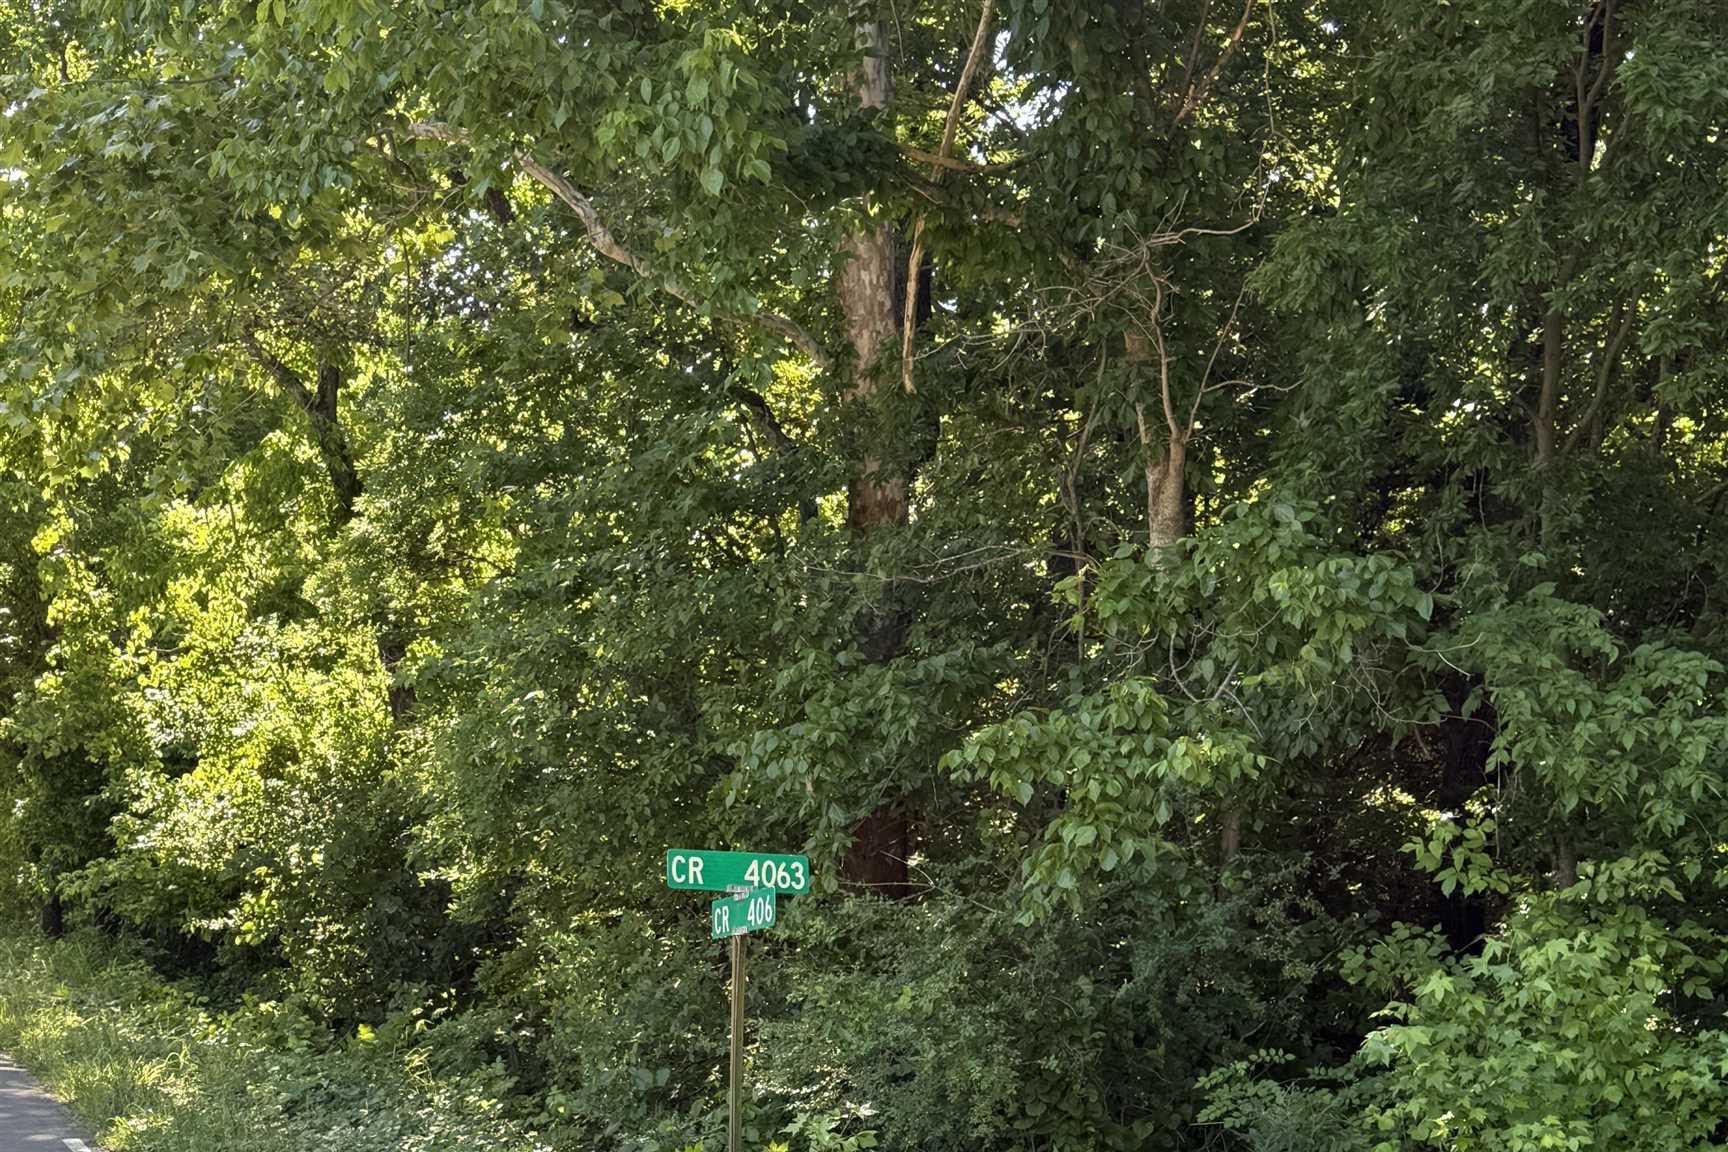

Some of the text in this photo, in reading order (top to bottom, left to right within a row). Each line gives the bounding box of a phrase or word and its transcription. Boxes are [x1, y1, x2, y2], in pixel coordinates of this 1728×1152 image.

[671, 855, 806, 890] CR 4063
[714, 896, 772, 934] CR 406
